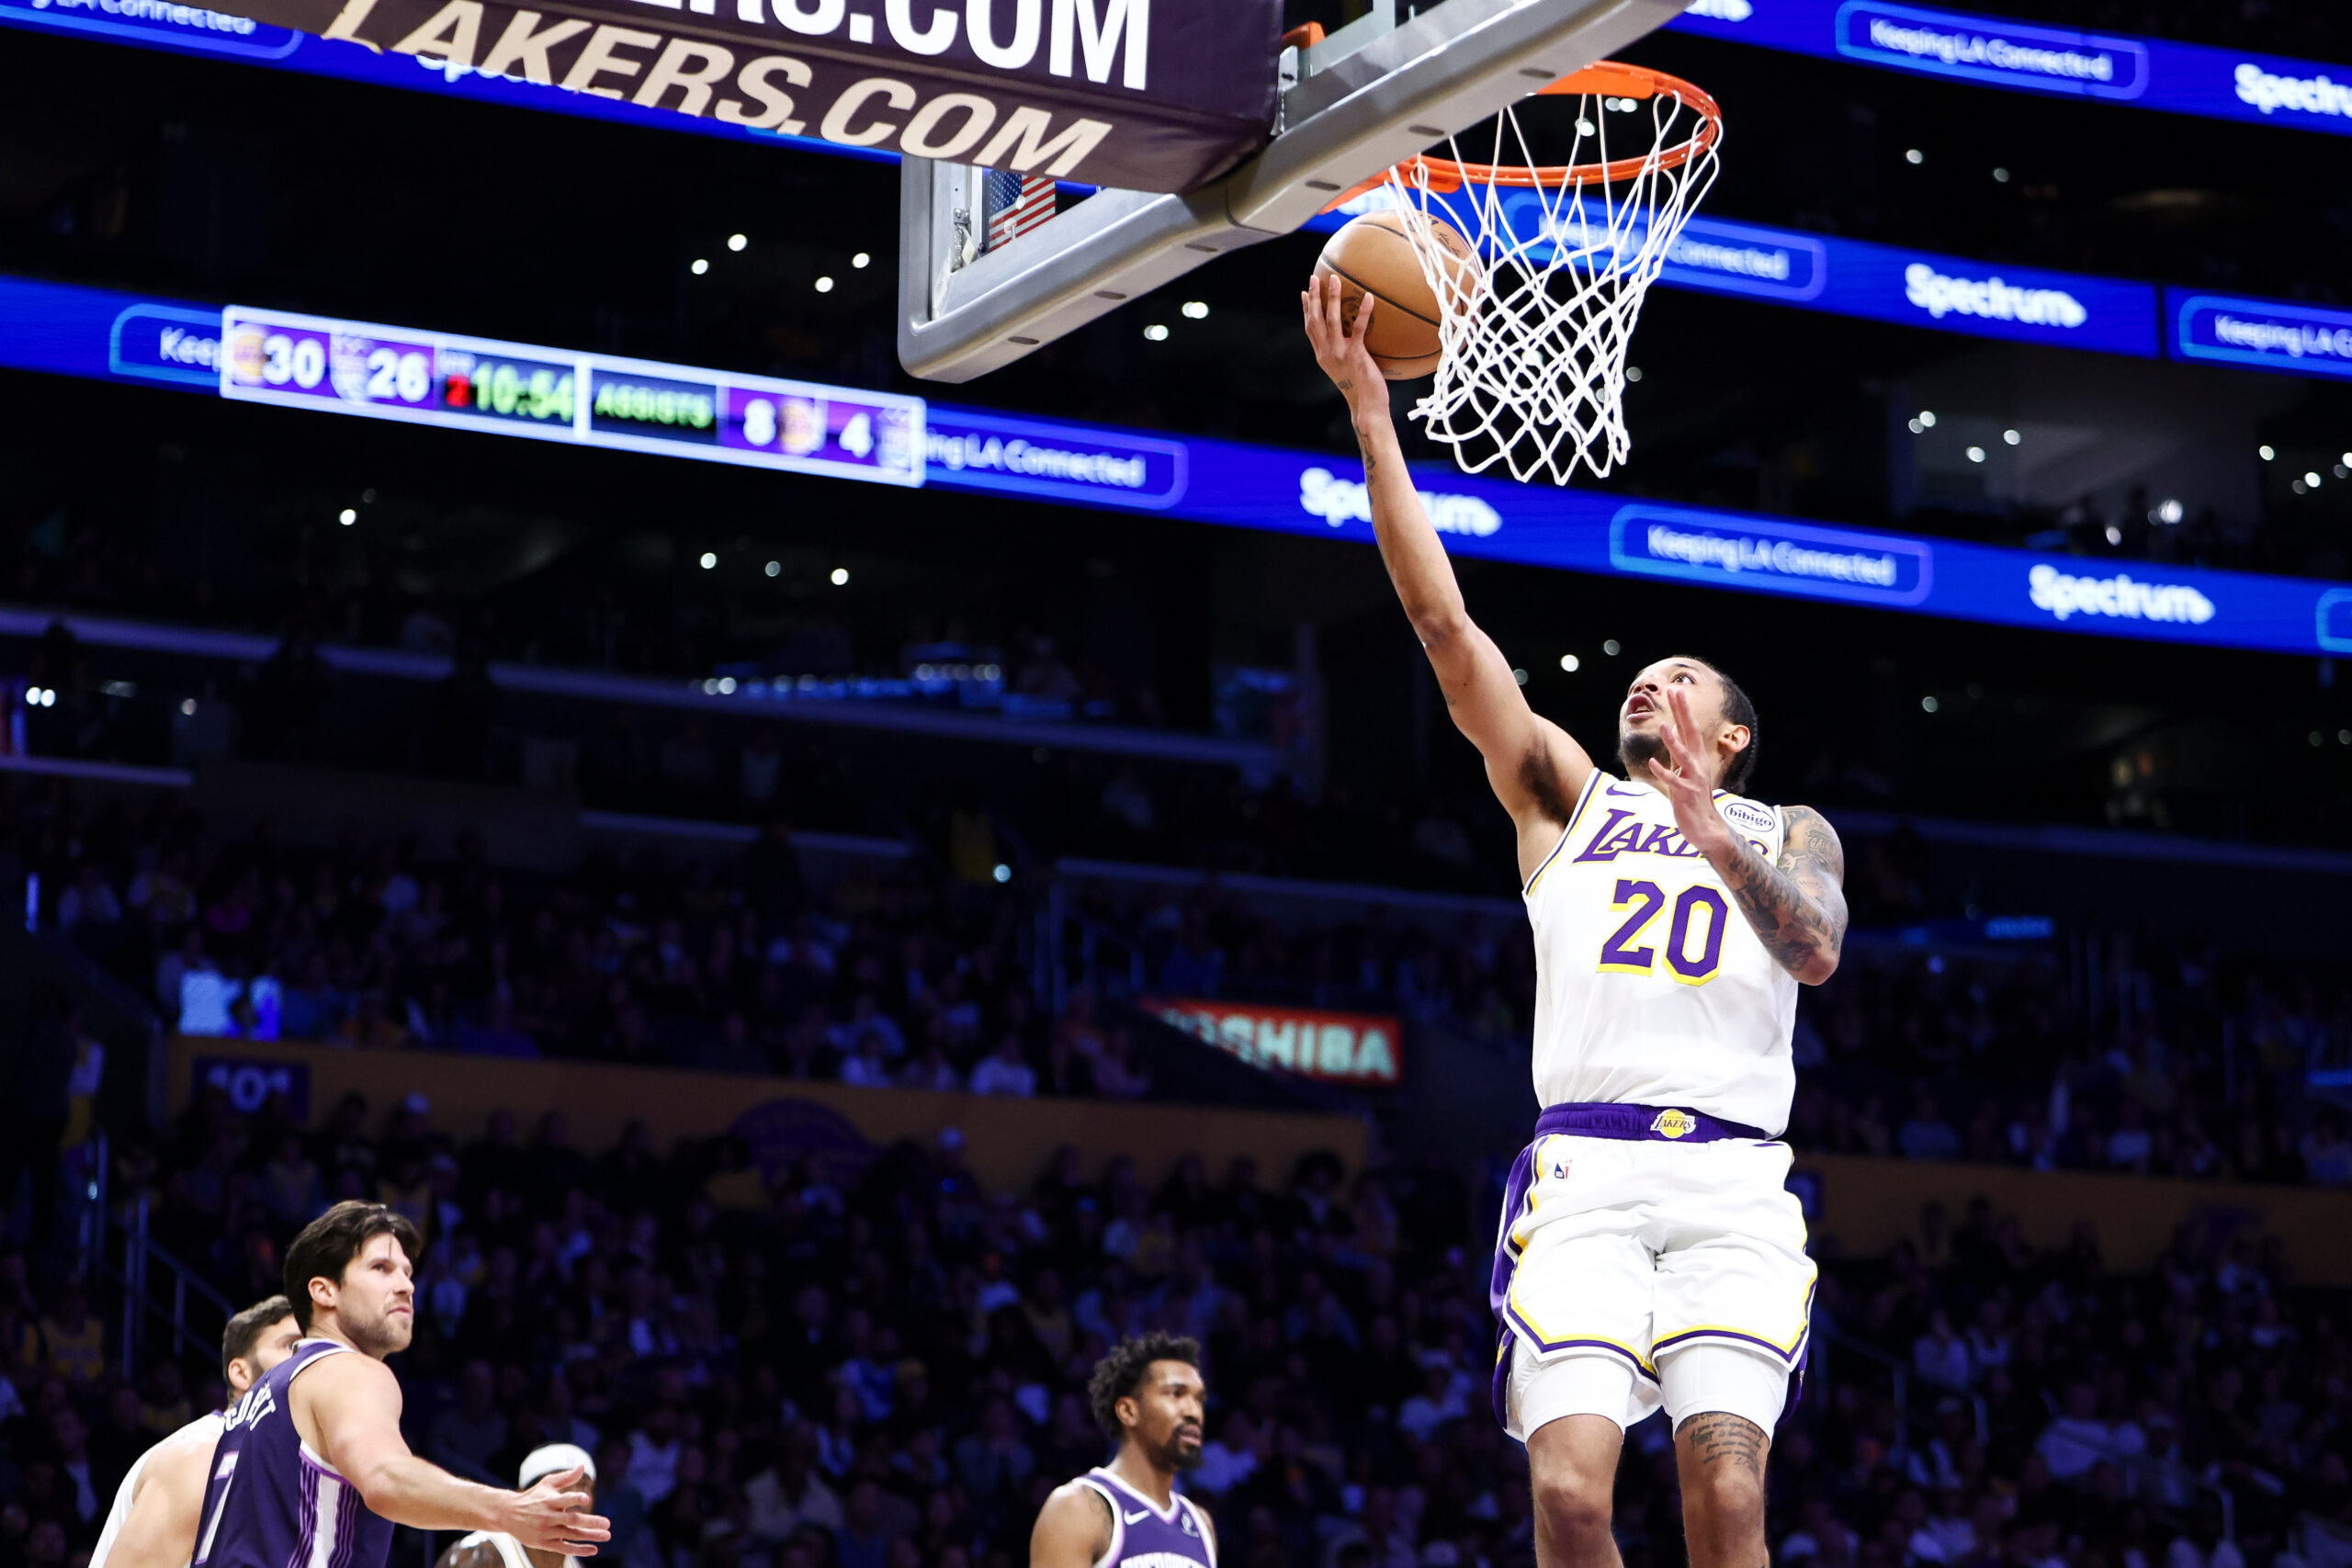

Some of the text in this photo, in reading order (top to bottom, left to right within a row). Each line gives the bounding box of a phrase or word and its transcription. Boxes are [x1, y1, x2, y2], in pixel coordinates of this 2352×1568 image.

[1870, 17, 2113, 82] Keeping LA Connected
[2234, 62, 2352, 118] Spectr
[1905, 263, 2088, 329] Spectrum
[263, 333, 324, 389] 30
[368, 347, 430, 403] 26
[839, 412, 874, 458] 4
[1003, 439, 1146, 489] Connected
[1647, 524, 1896, 587] Keeping LA Connected
[2029, 563, 2216, 625] Spectrum
[1729, 807, 1772, 827] bibigo
[1597, 878, 1729, 987] 20
[1654, 1115, 1691, 1132] LAKERS
[195, 1450, 240, 1564] 7
